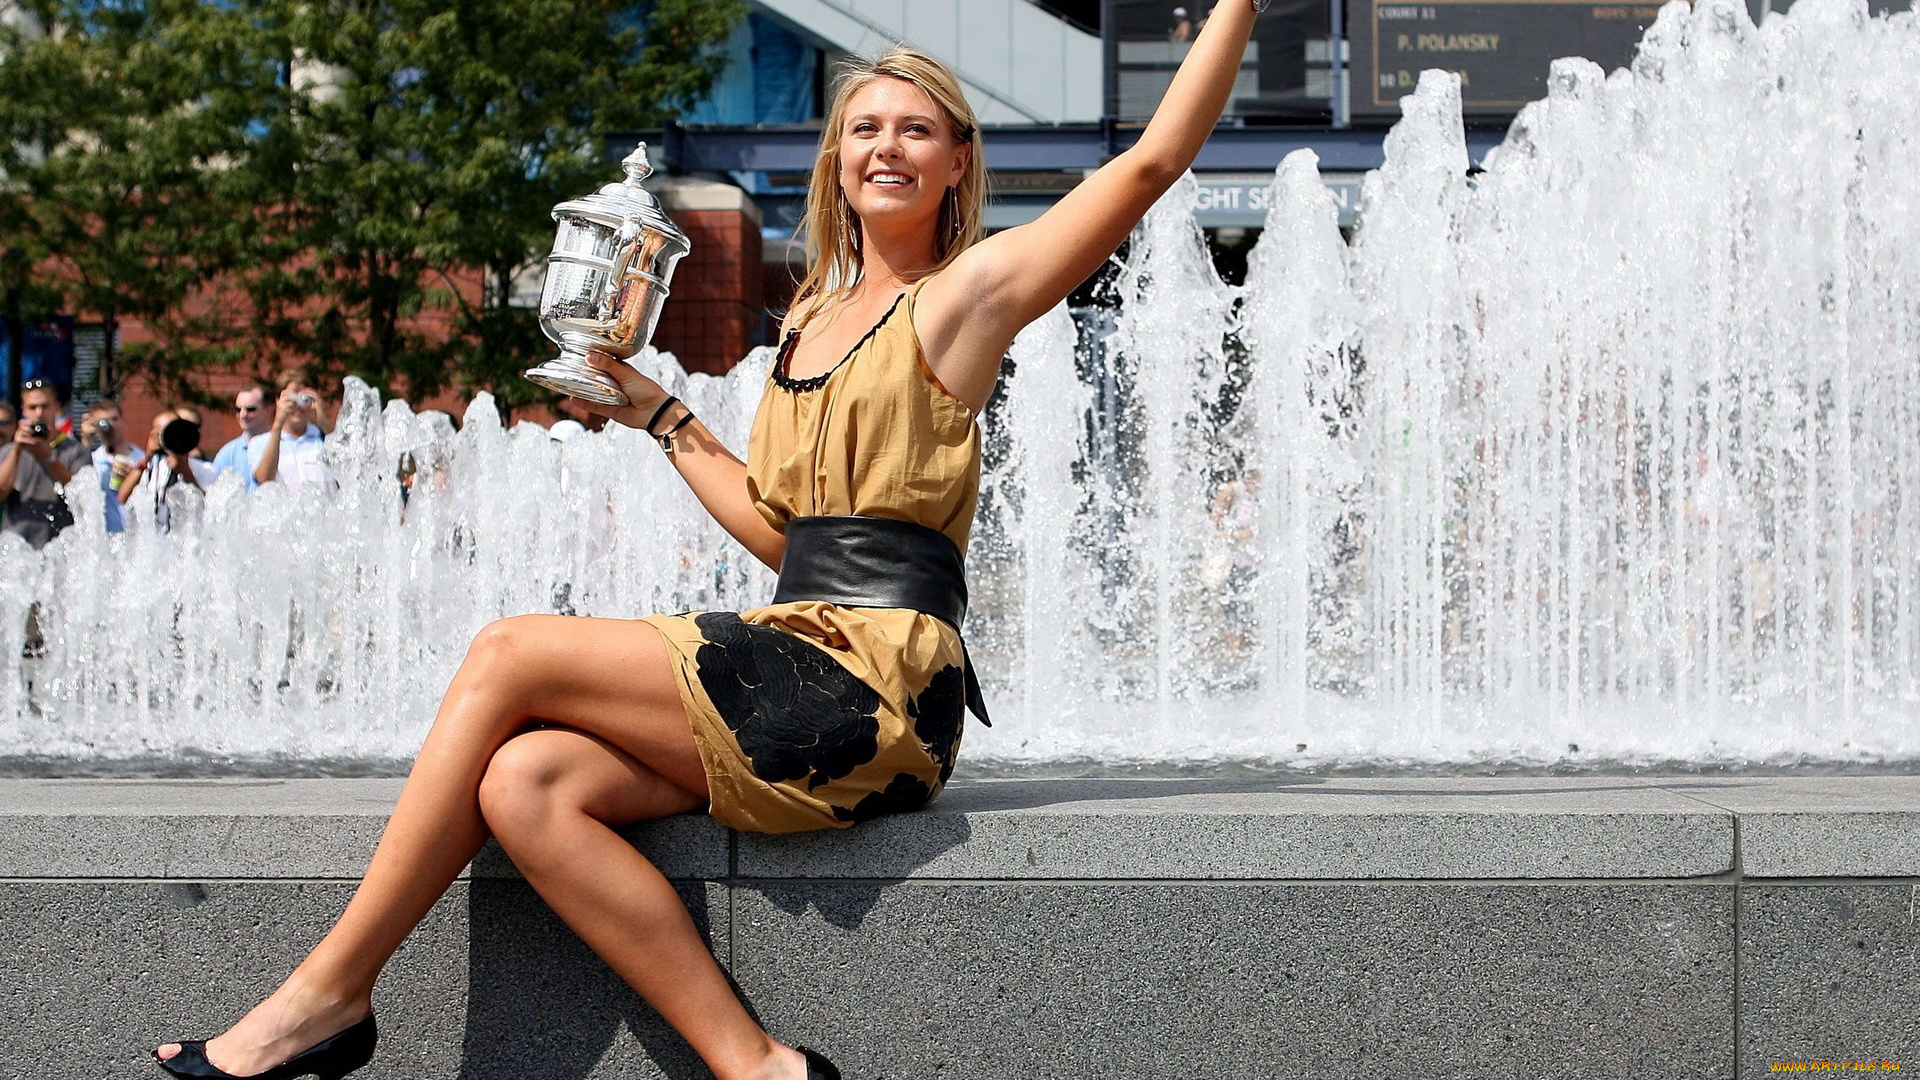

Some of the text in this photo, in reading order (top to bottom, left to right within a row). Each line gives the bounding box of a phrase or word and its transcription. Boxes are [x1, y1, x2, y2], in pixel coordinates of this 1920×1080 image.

[1397, 34, 1499, 50] P. POLANSKY
[1193, 187, 1243, 210] GHT
